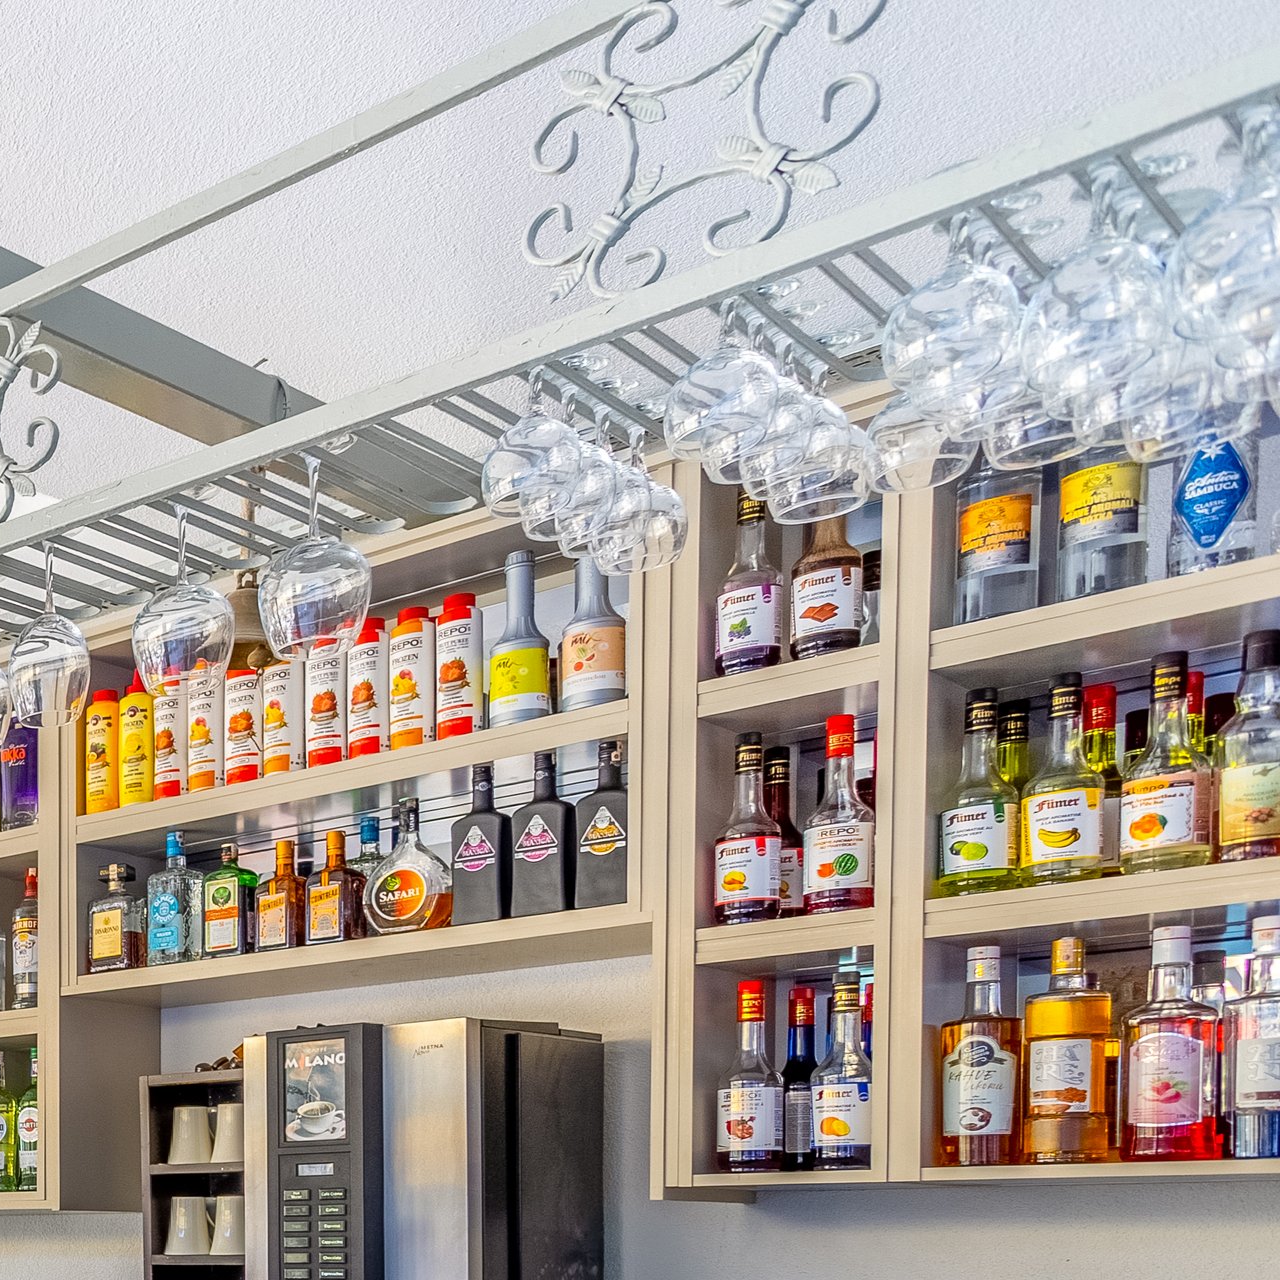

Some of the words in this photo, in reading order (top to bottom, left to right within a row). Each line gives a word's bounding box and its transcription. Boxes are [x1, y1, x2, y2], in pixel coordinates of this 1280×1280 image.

[1184, 481, 1239, 500] SAMBUCA
[797, 574, 836, 593] Fümer
[721, 592, 756, 610] Fümer
[437, 626, 467, 639] REPO
[391, 639, 419, 653] REPO
[309, 659, 338, 671] REPO
[1033, 797, 1080, 814] Fümer
[945, 811, 988, 828] Fümer
[819, 827, 857, 838] REPO
[718, 845, 751, 861] Fümer
[378, 887, 421, 902] SAFARI
[94, 924, 120, 936] DISARONNO
[284, 1053, 346, 1069] MILANO
[948, 1069, 998, 1083] KAHVE
